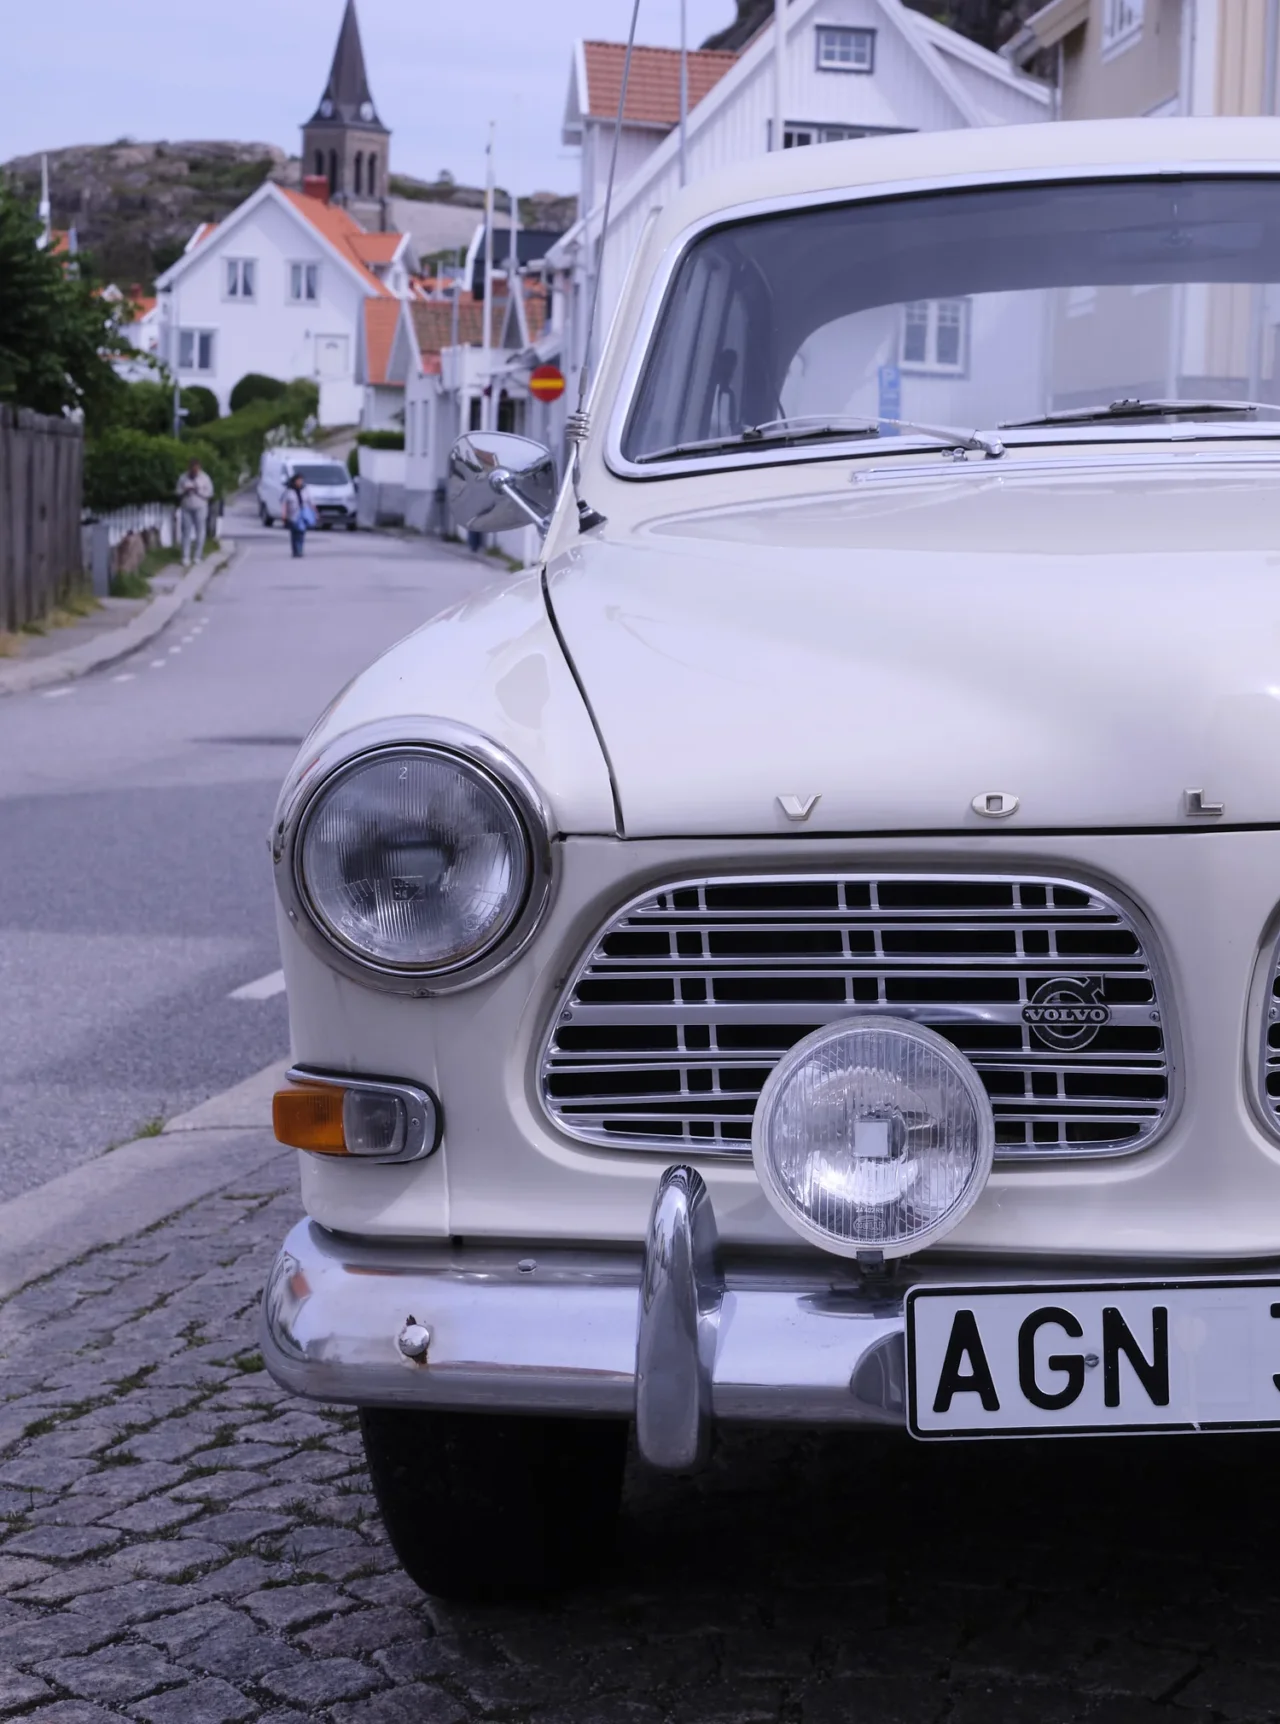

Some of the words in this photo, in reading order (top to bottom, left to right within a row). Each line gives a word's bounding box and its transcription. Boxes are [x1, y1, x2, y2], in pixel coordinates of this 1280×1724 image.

[399, 766, 408, 780] 2
[1024, 1008, 1105, 1021] VOLVO
[933, 1305, 1170, 1412] AGN
